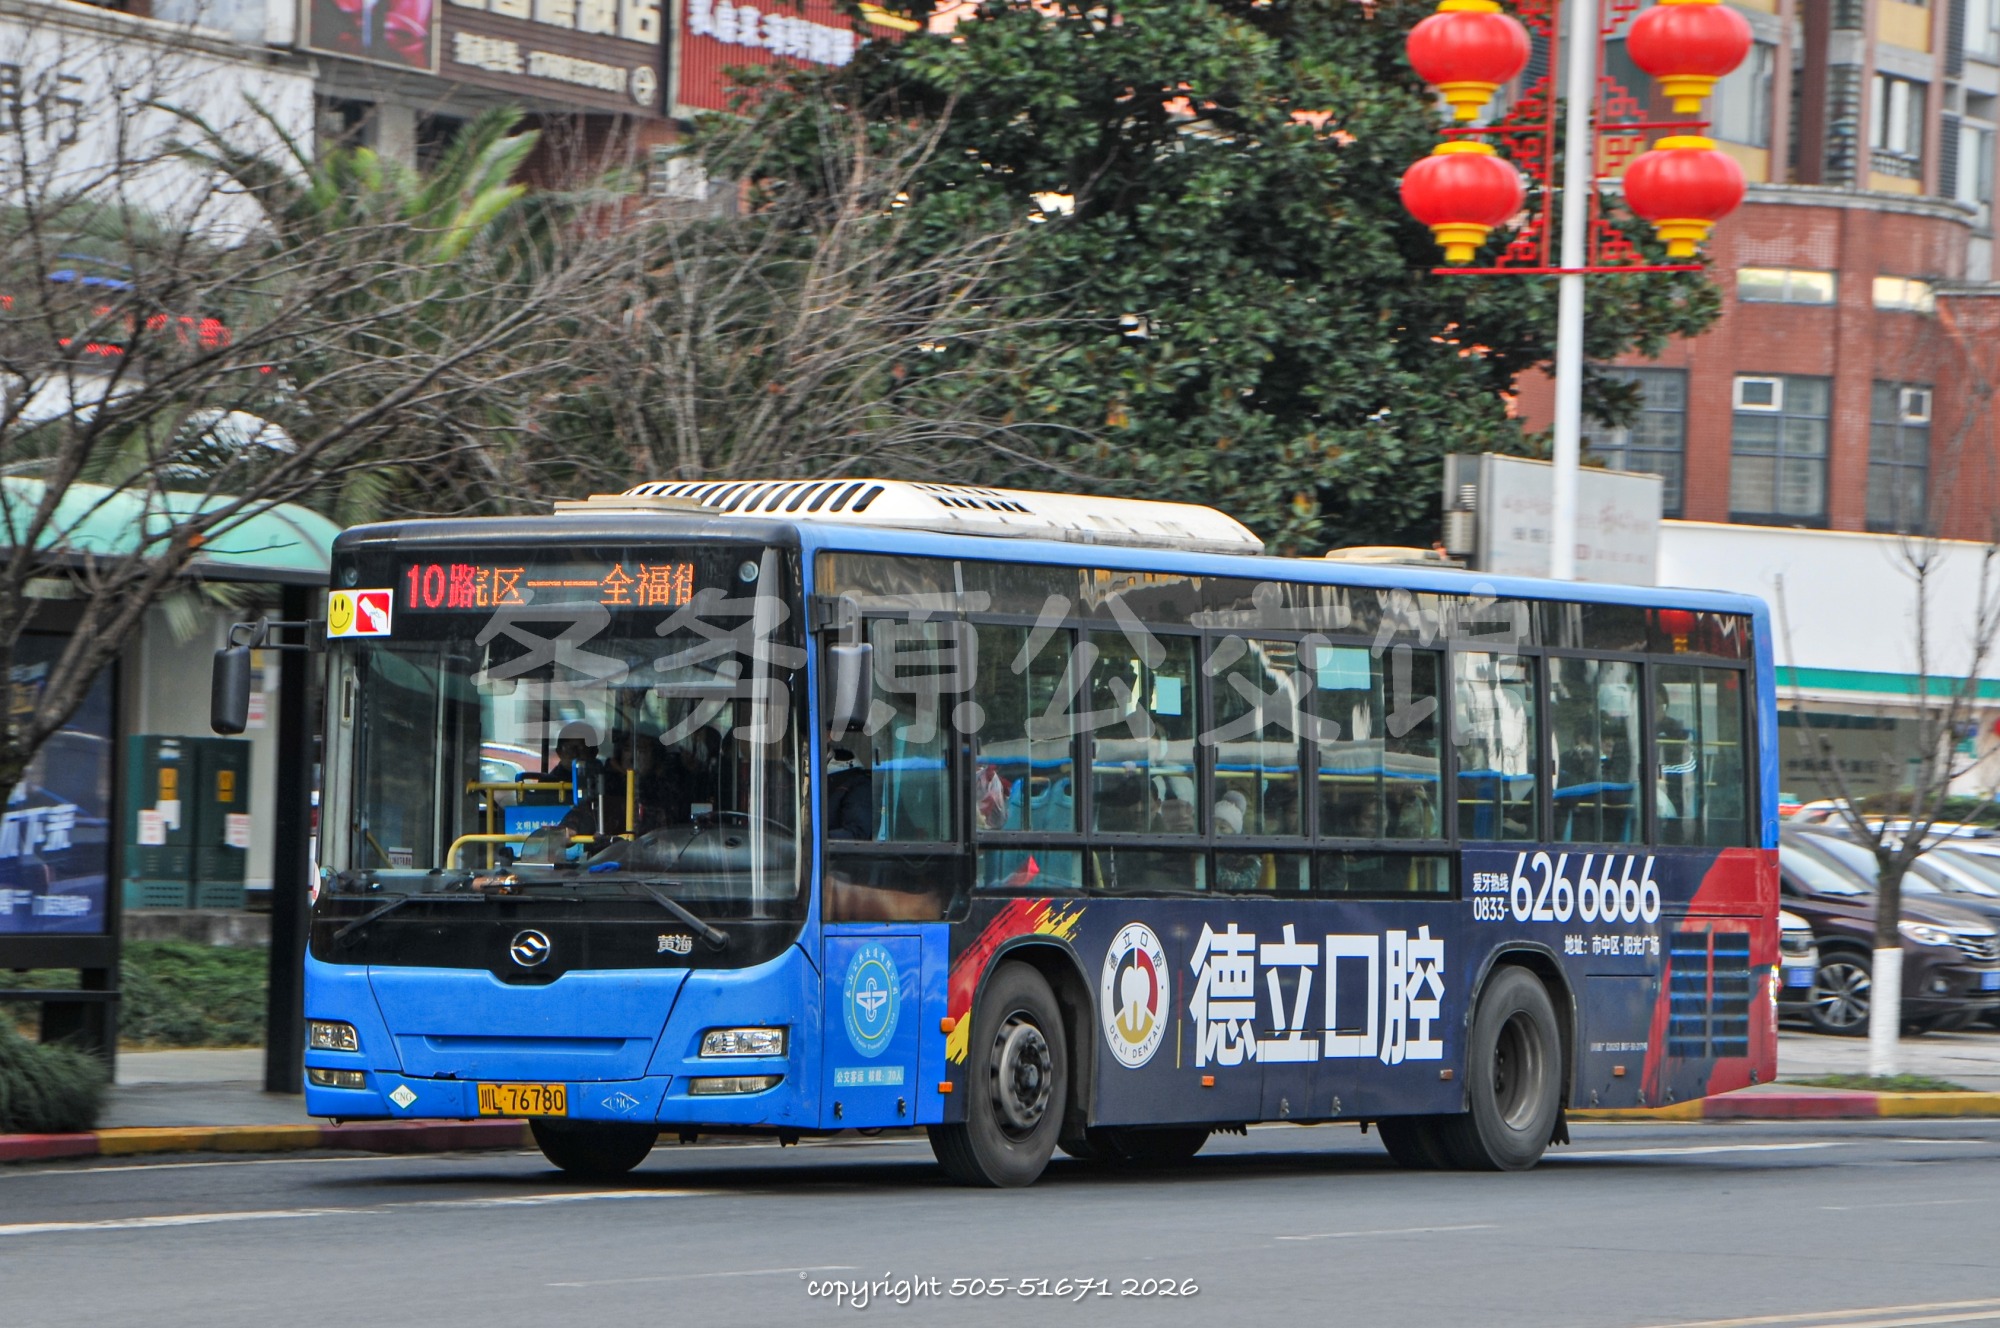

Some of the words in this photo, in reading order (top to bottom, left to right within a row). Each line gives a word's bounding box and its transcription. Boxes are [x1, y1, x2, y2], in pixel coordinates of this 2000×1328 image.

[407, 564, 475, 608] 10路
[1473, 873, 1509, 892] 爱牙热线
[1189, 922, 1445, 1067] 德立口腔
[393, 1091, 412, 1102] CNG
